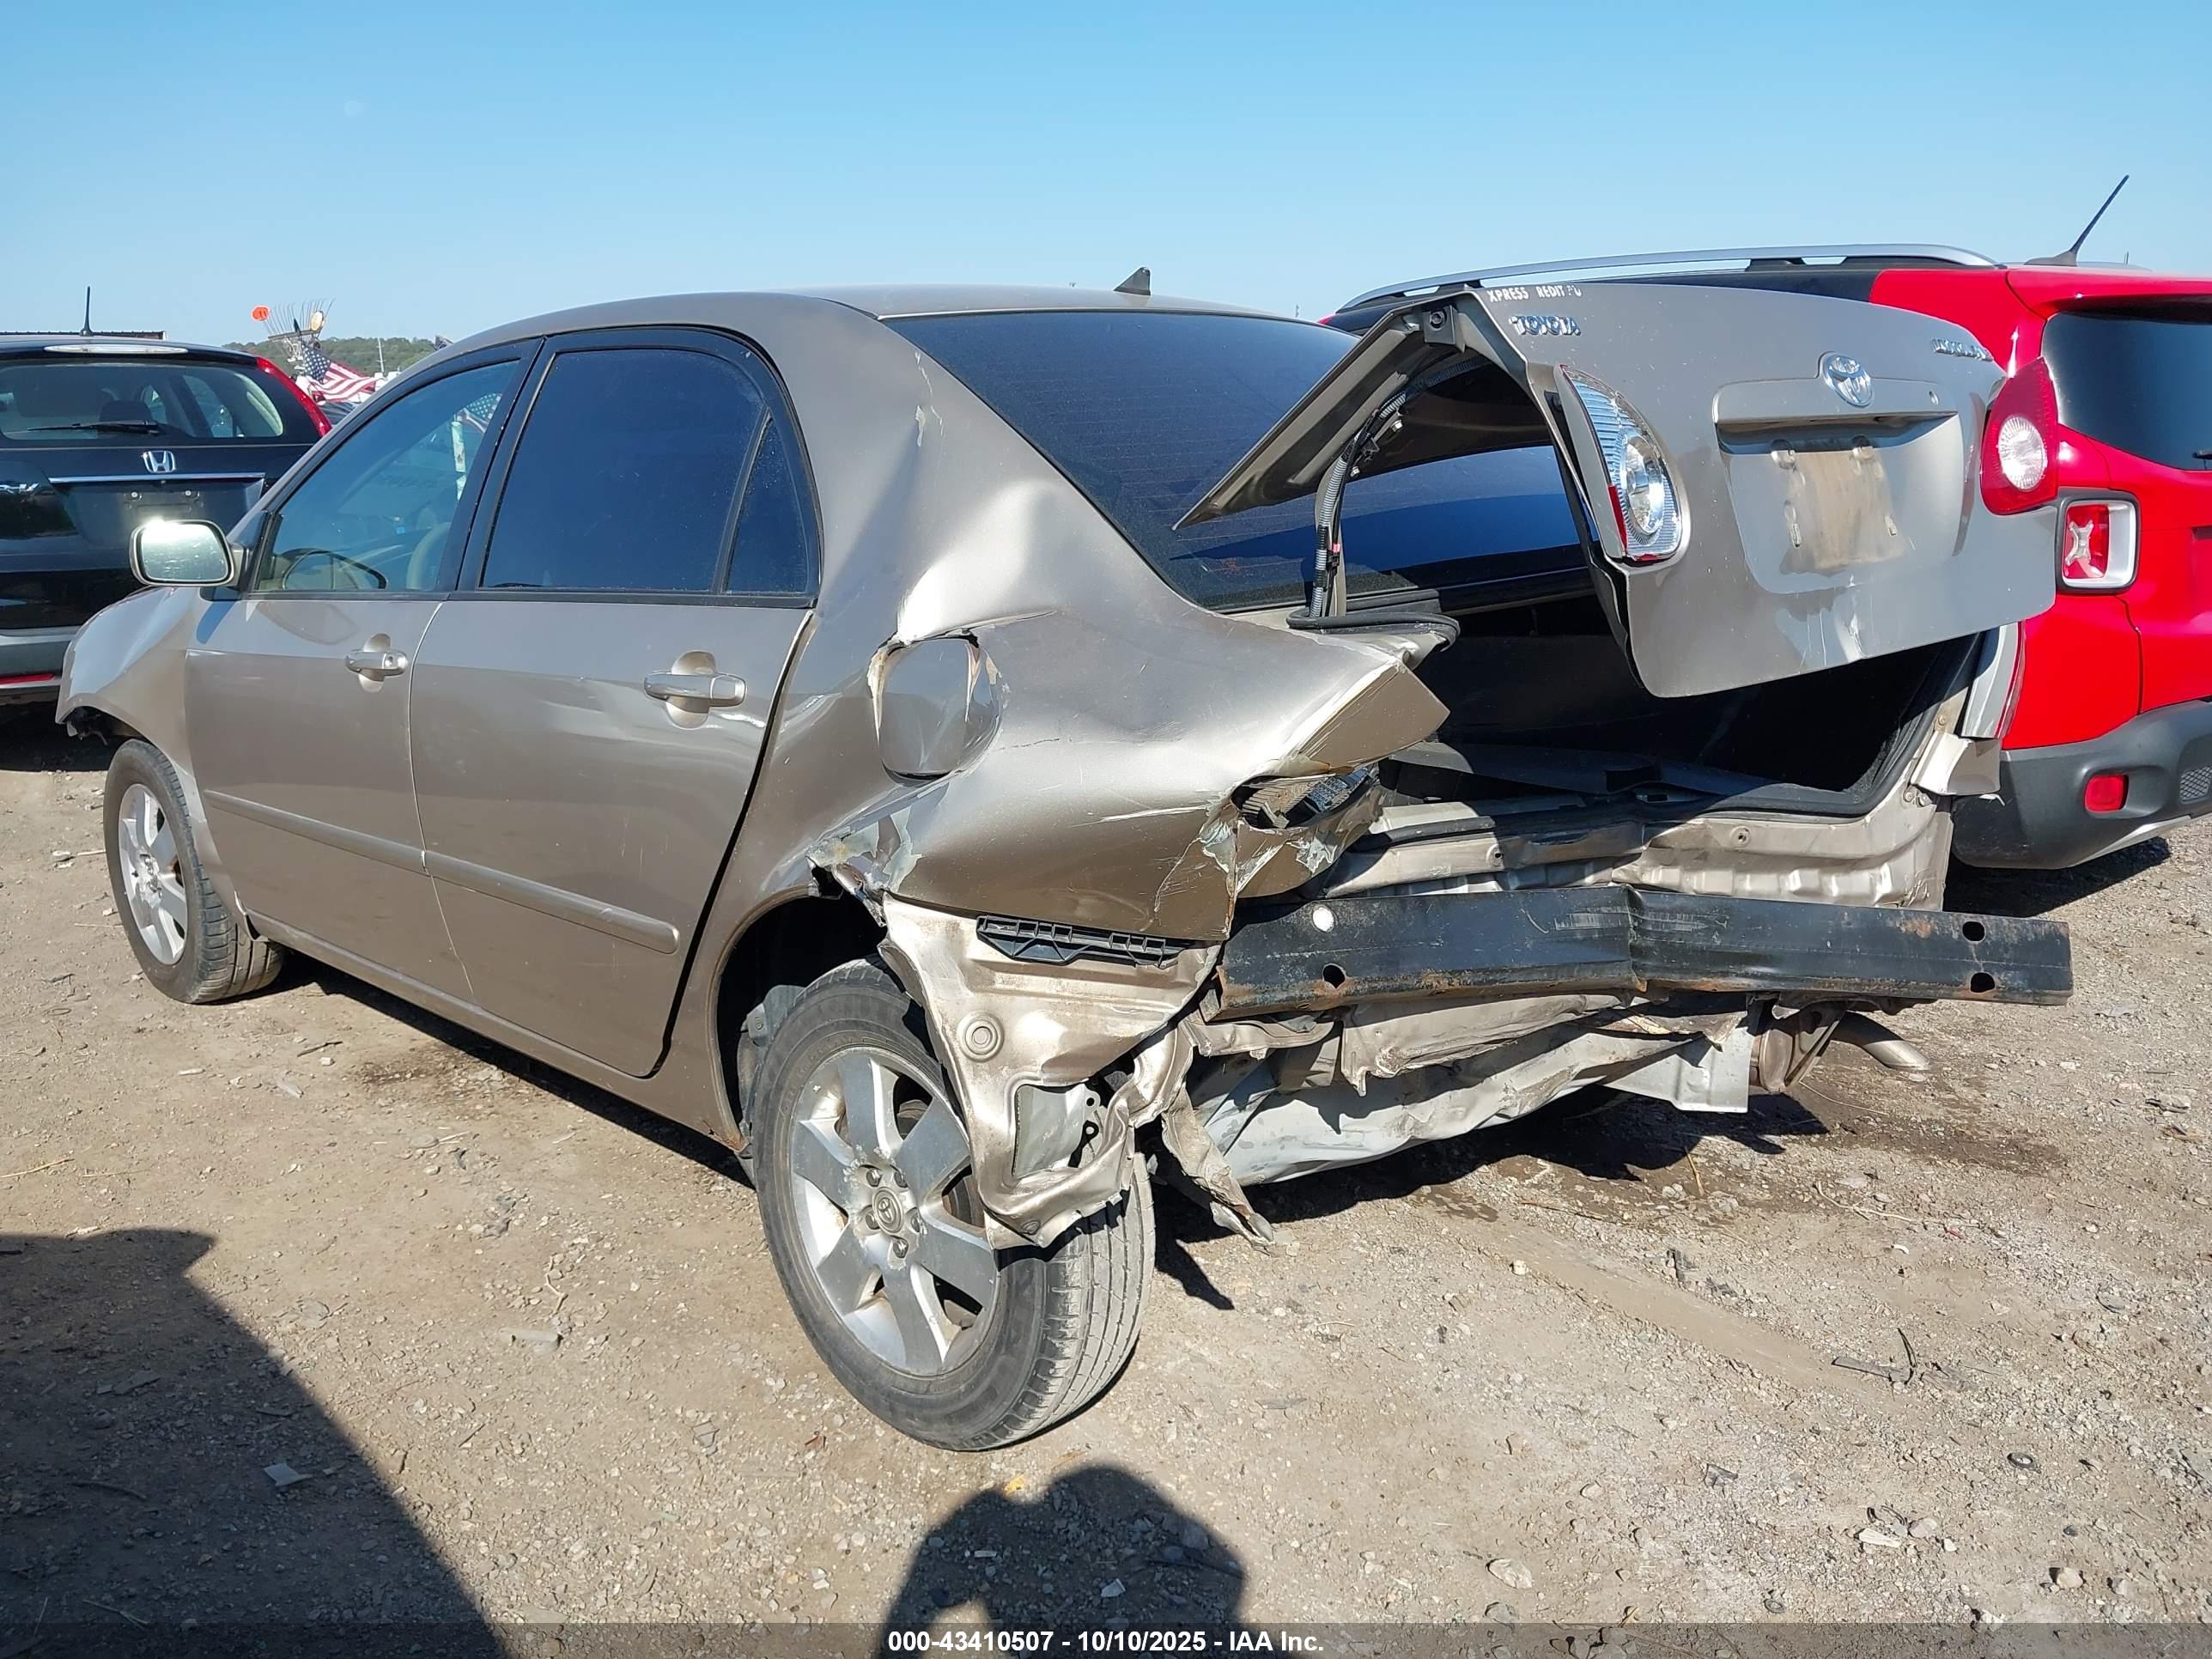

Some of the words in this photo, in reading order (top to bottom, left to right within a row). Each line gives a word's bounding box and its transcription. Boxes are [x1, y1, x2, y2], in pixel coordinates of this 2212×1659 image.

[1486, 286, 1529, 302] XPRESS
[1535, 284, 1565, 298] REDIT
[1509, 315, 1582, 336] TOYOTA
